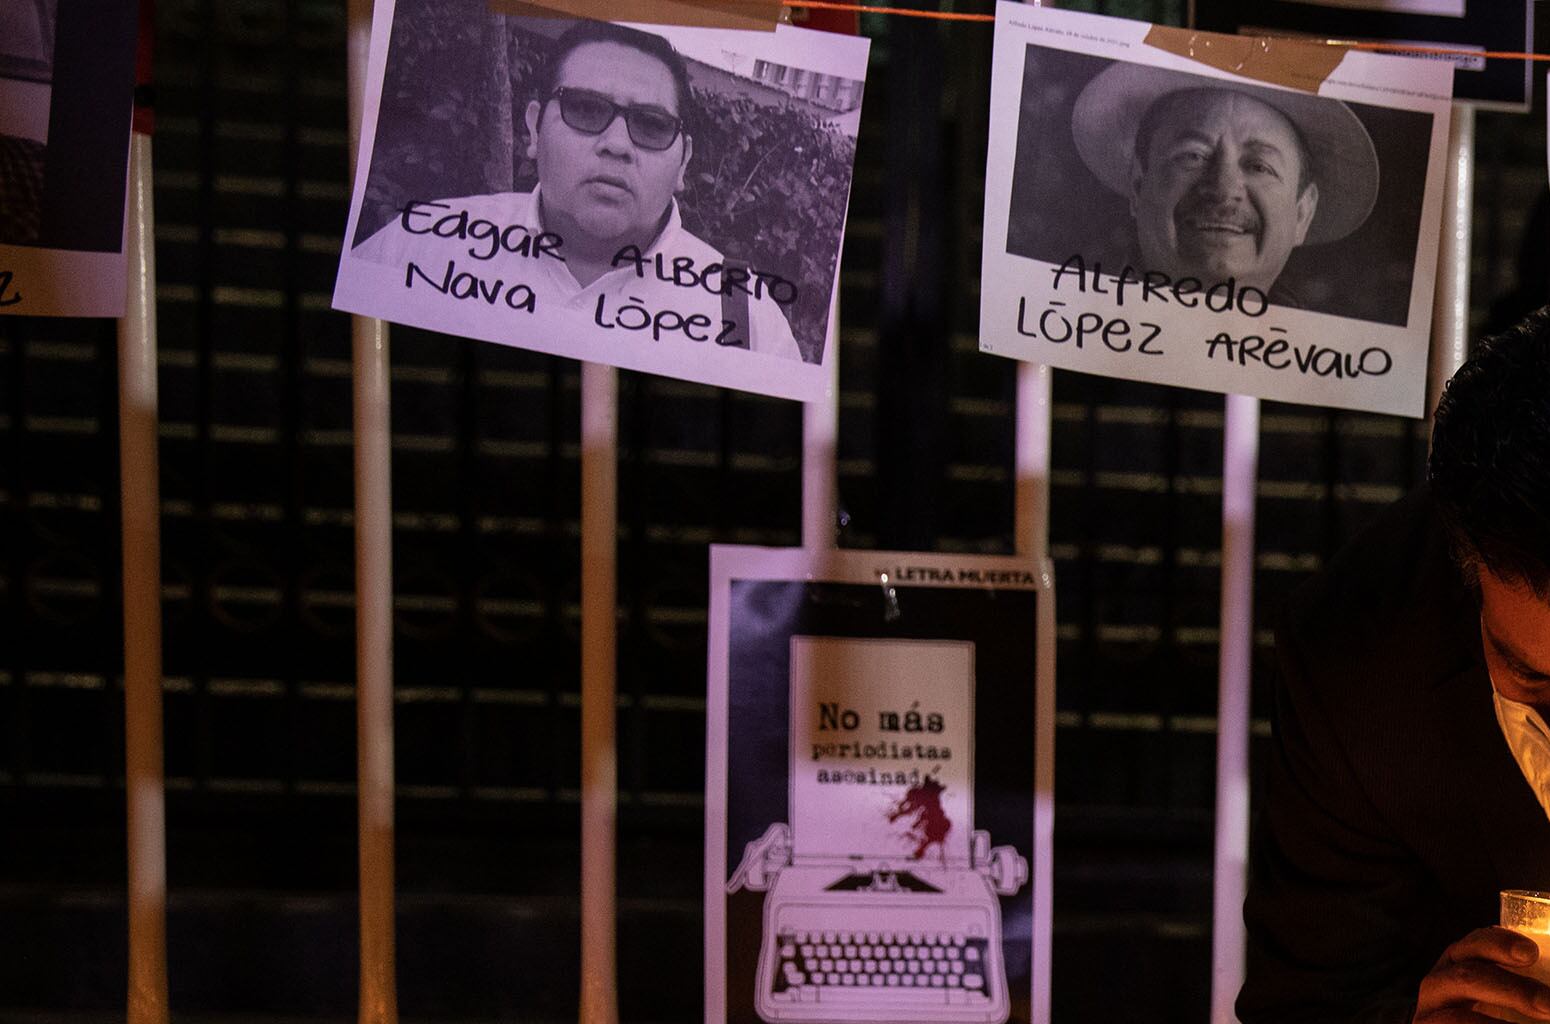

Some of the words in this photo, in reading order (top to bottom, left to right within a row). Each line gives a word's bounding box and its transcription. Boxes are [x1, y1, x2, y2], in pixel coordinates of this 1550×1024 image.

[405, 260, 537, 313] Nava
[896, 566, 954, 582] LETRA
[959, 569, 1035, 584] MUERTA
[819, 702, 861, 732] No
[878, 701, 945, 733] más
[811, 740, 952, 761] periodistas
